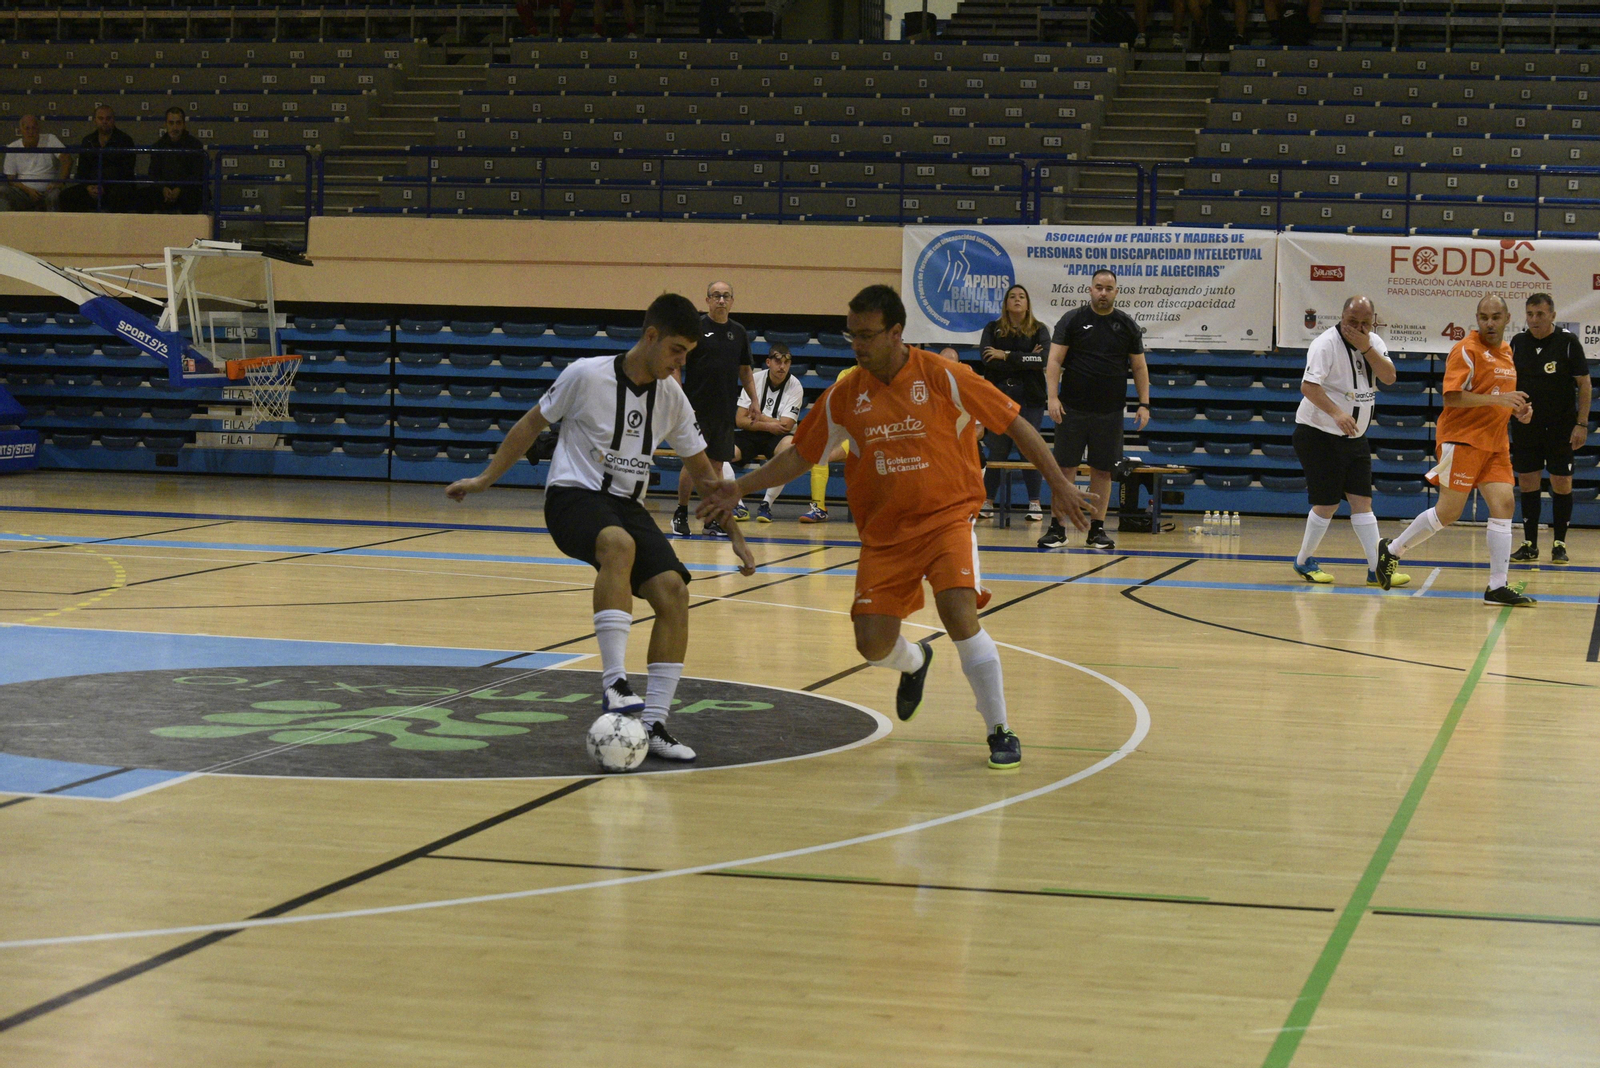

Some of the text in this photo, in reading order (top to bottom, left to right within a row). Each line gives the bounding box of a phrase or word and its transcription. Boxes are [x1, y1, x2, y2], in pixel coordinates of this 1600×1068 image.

[1046, 232, 1245, 243] ASOCIACIÓN DE PADRES Y MADRES DE
[1027, 246, 1262, 260] PERSONAS CON DISCAPACIDAD INTELECTUAL
[1110, 263, 1143, 276] BAHÍA
[1145, 265, 1158, 276] DE
[964, 274, 1010, 288] APADIS
[1388, 278, 1442, 286] FEDERACIÓN
[1446, 278, 1494, 288] CÁNTABRA
[1510, 282, 1552, 290] DEPORTE
[1051, 284, 1236, 296] Más de ños trabajando junto
[1411, 288, 1482, 298] DISCAPACITADOS
[1060, 298, 1077, 306] las
[1157, 299, 1236, 310] discapacidad
[1134, 312, 1181, 322] familias
[227, 328, 257, 337] FILA 5
[222, 390, 245, 399] FILA
[224, 420, 245, 430] FILA
[864, 415, 925, 438] empate
[221, 435, 252, 444] FILA 1
[886, 456, 921, 465] Gobierno
[897, 462, 929, 472] Canarias
